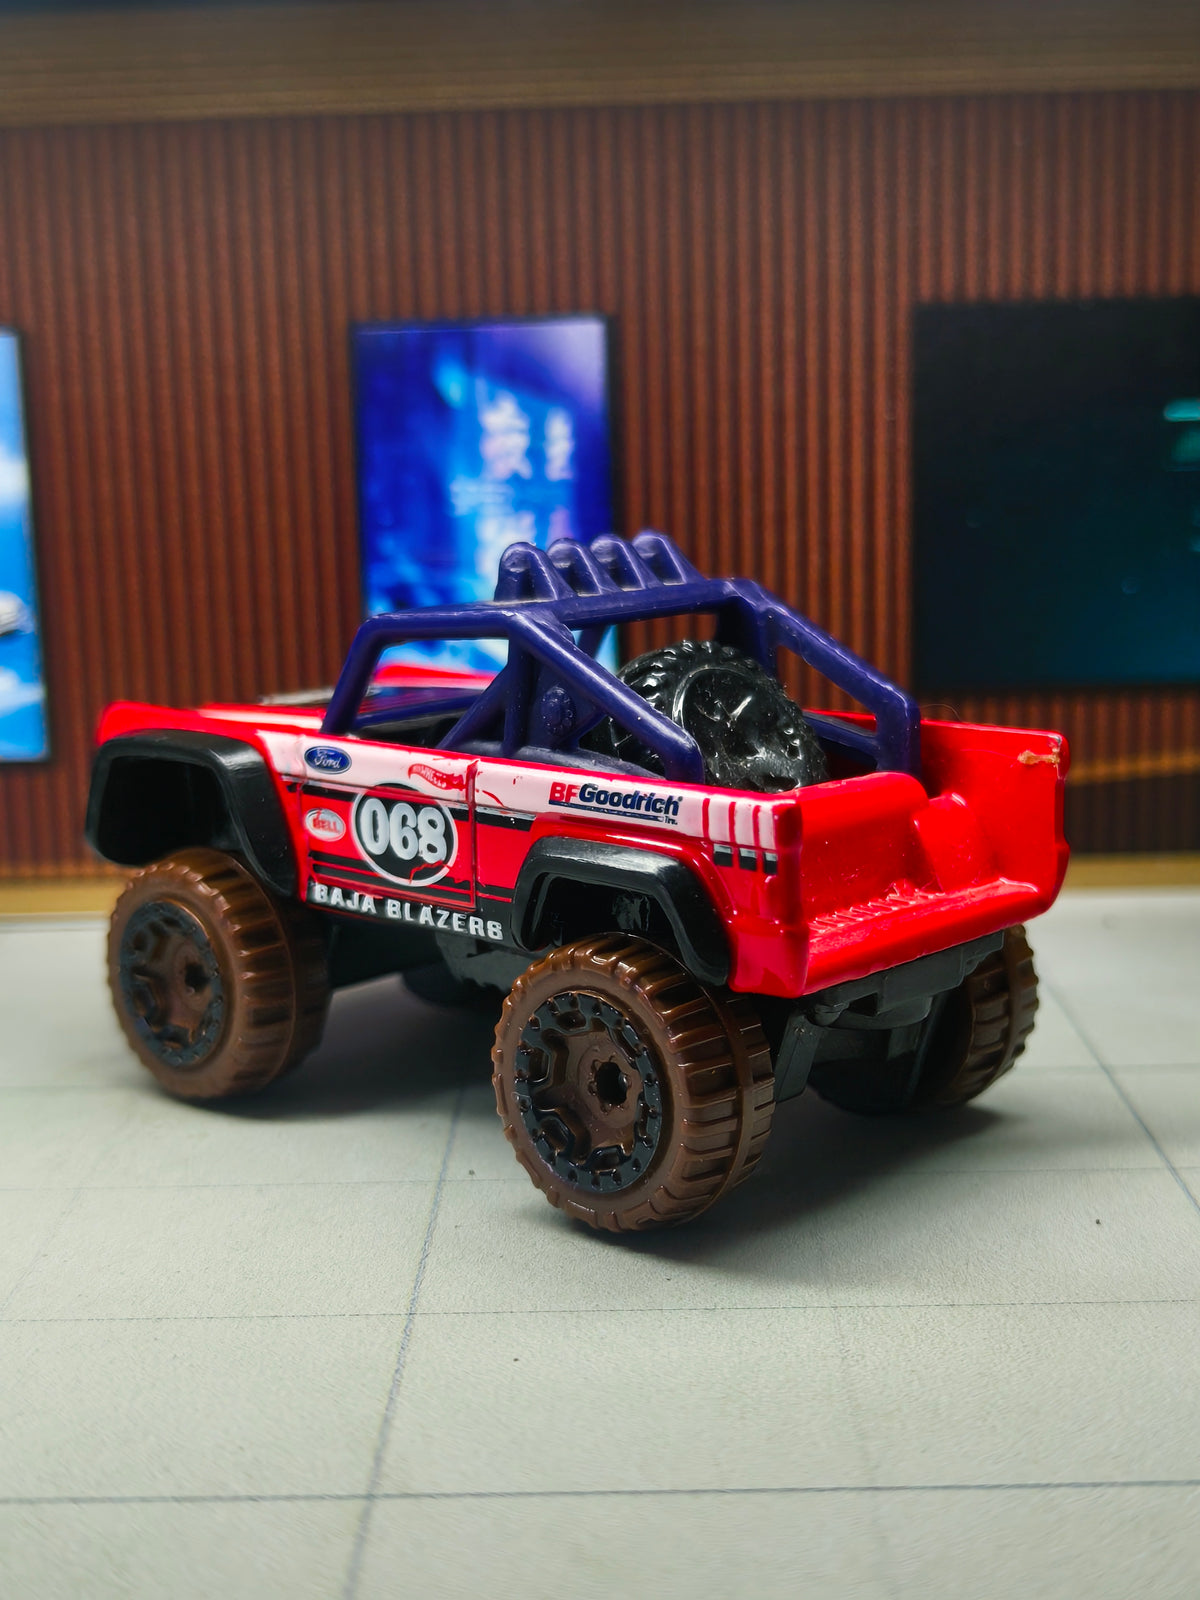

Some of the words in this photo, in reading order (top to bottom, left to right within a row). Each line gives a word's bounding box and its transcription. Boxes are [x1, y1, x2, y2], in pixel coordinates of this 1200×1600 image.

[313, 750, 342, 769] Ford
[549, 781, 680, 816] BFGoodrich
[360, 797, 447, 864] 068
[315, 883, 377, 914] BAJA
[387, 900, 504, 941] BLAZERS
